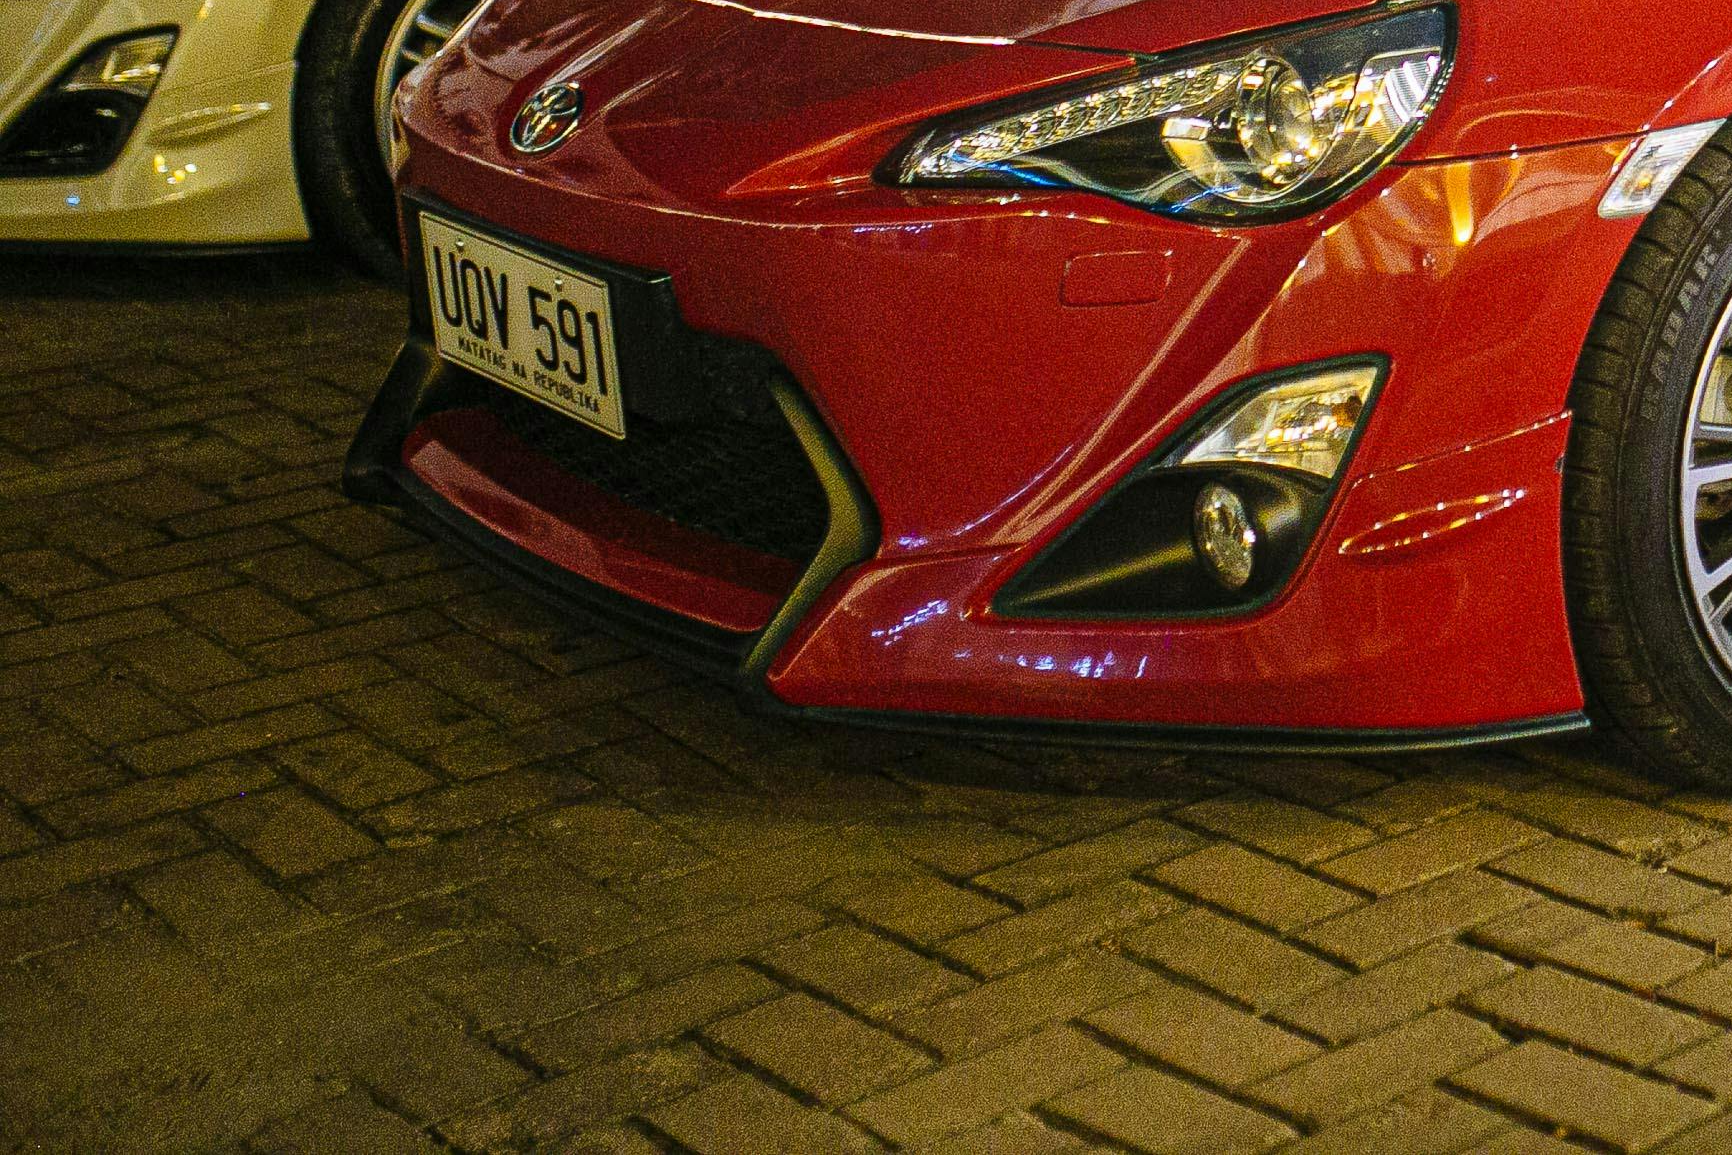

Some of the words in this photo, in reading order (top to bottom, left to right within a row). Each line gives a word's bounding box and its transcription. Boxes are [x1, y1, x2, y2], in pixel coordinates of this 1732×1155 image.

[433, 245, 509, 350] UQV
[527, 285, 609, 397] 591
[457, 336, 507, 371] MATATAG
[512, 361, 527, 380] NA
[533, 370, 601, 414] REPUBLIKA
